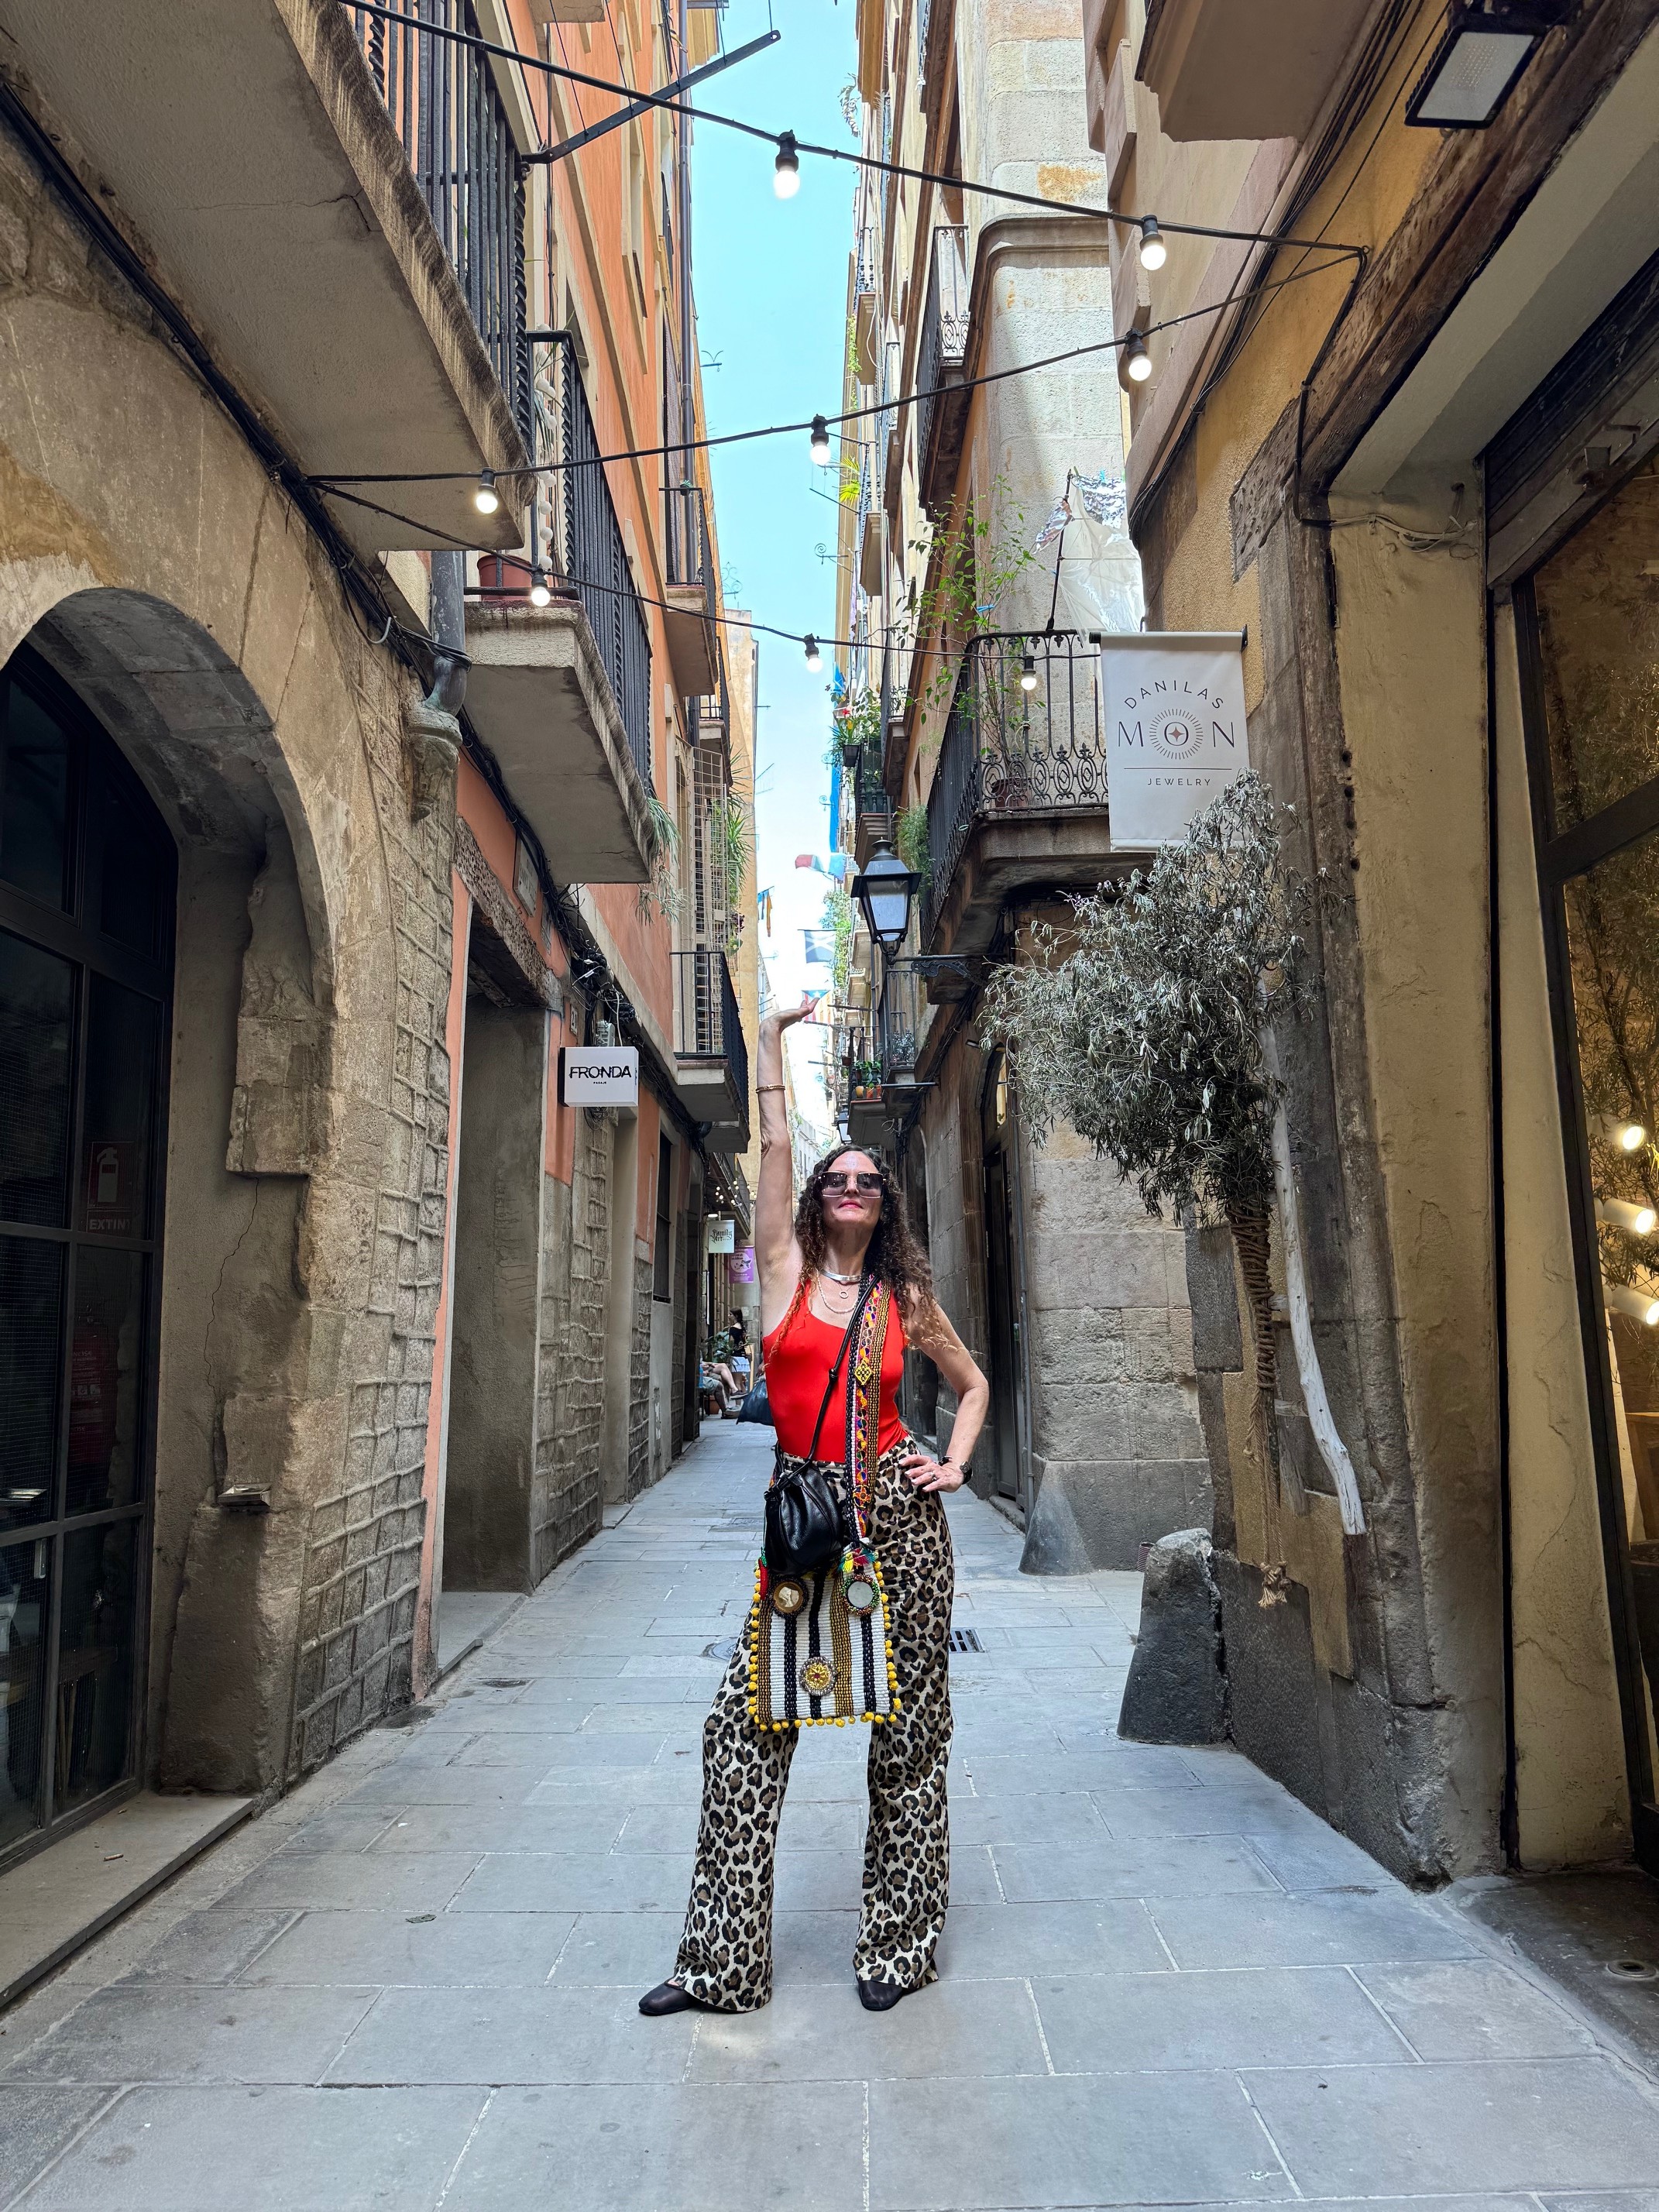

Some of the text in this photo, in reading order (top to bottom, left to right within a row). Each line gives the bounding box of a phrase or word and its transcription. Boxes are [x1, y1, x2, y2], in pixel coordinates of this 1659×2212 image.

[1124, 680, 1224, 709] DANILAS
[1118, 721, 1235, 748] MON
[569, 1066, 632, 1079] FRONDA
[712, 1229, 733, 1240] Family
